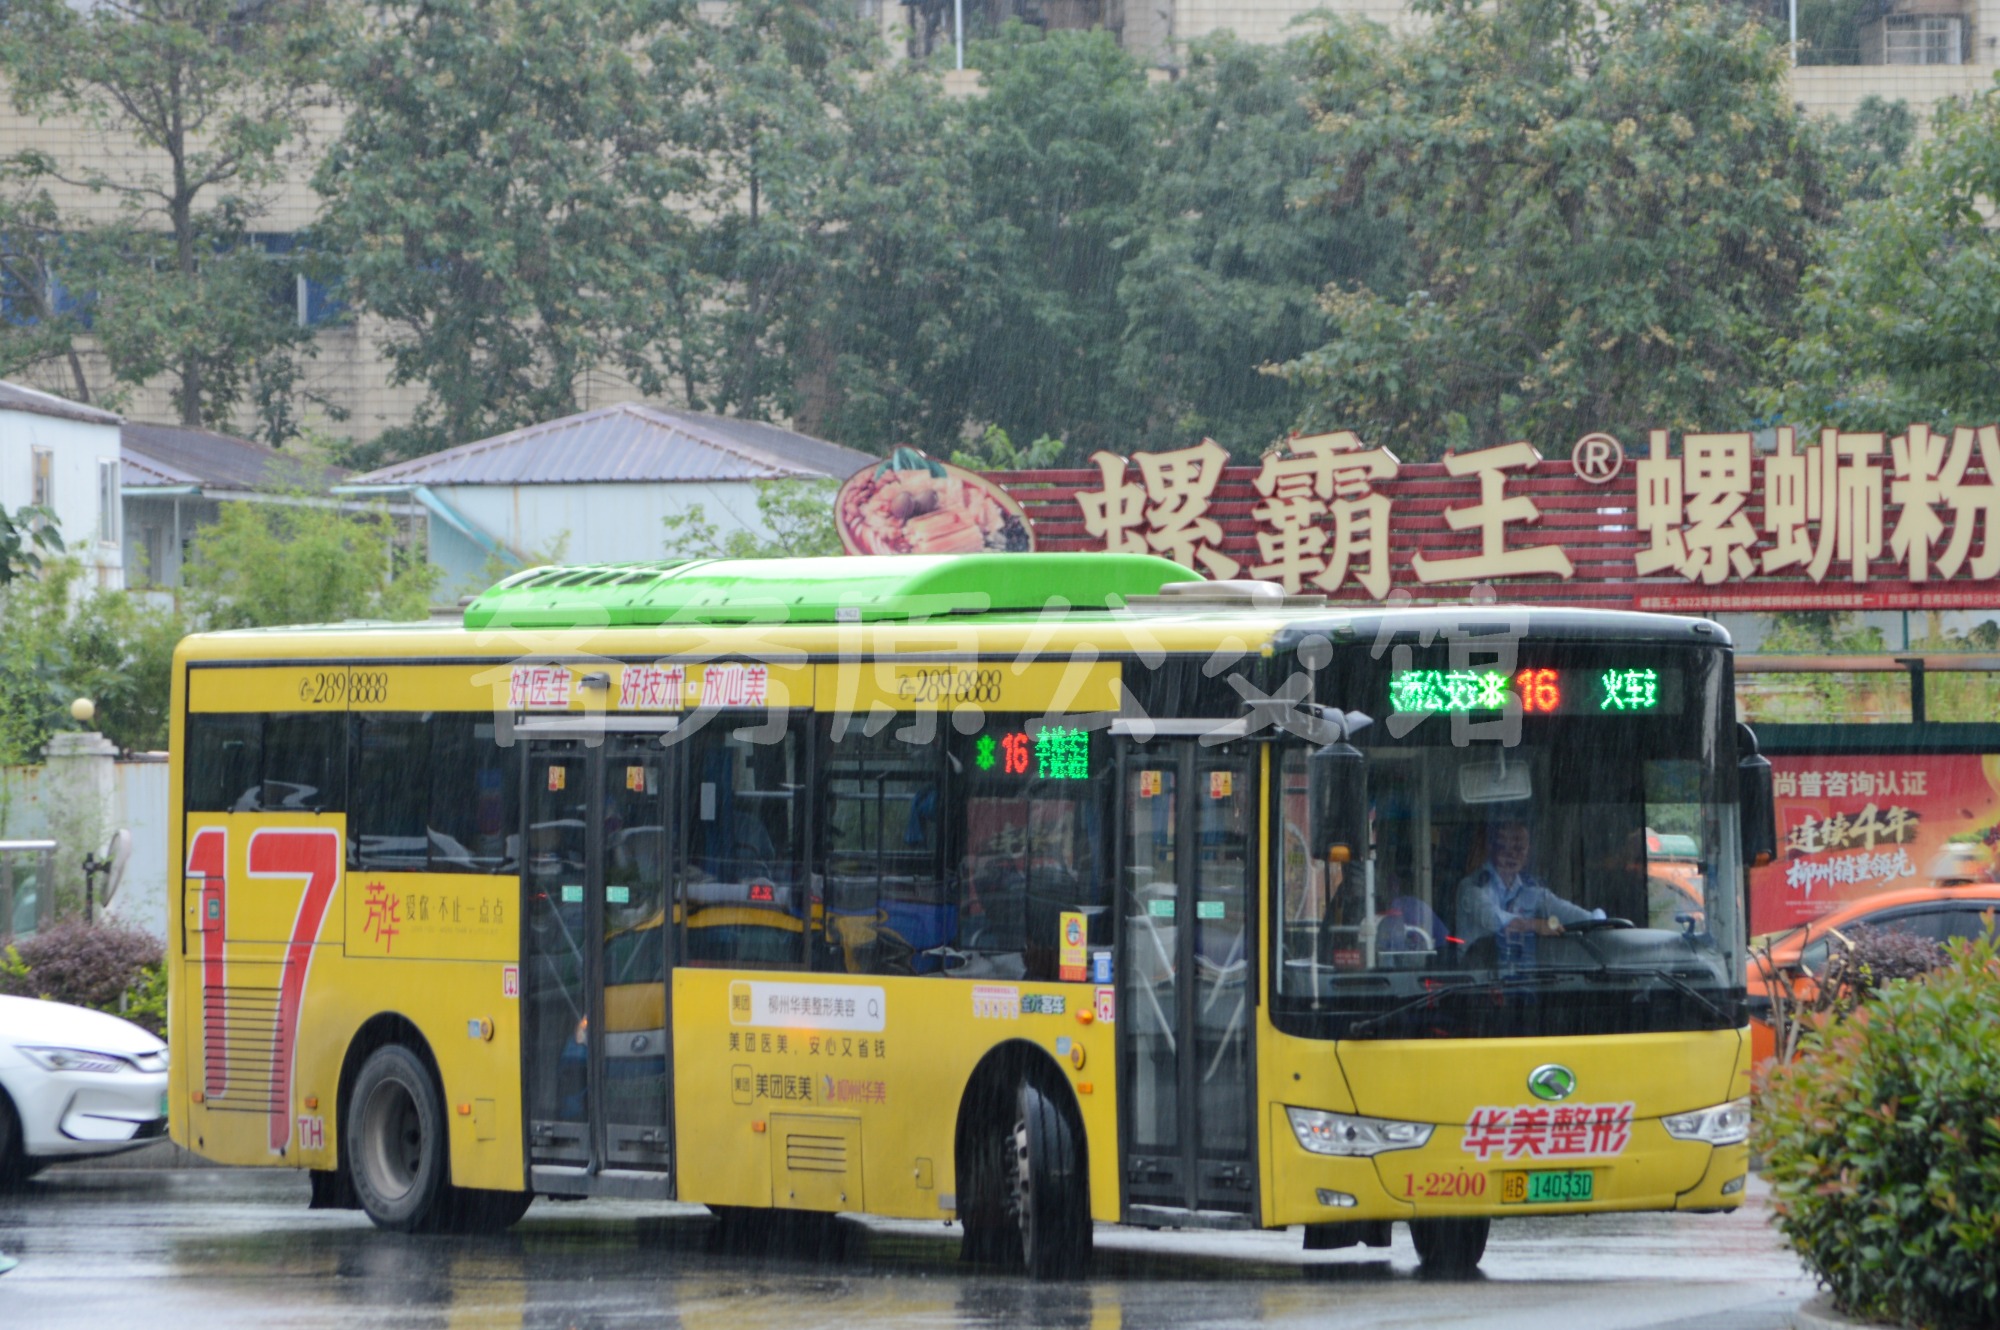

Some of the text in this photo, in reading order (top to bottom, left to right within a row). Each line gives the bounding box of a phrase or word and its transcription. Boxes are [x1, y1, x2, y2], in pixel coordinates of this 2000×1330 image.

[1074, 430, 1575, 600] 螺霸王
[1635, 422, 2000, 585] 螺蛳粉
[1516, 668, 1560, 712] 16
[1002, 732, 1029, 774] 16
[1773, 770, 1928, 798] 尚普咨询认证
[1785, 803, 1920, 854] 连续4年
[1786, 848, 1916, 899] 柳州销量领先
[188, 827, 338, 1153] 17
[768, 995, 856, 1018] 柳州华美整形美容
[756, 1073, 812, 1101] 美团医美
[298, 1117, 322, 1148] TH
[1464, 1104, 1632, 1157] 华美整形
[1403, 1171, 1486, 1198] 1-2200
